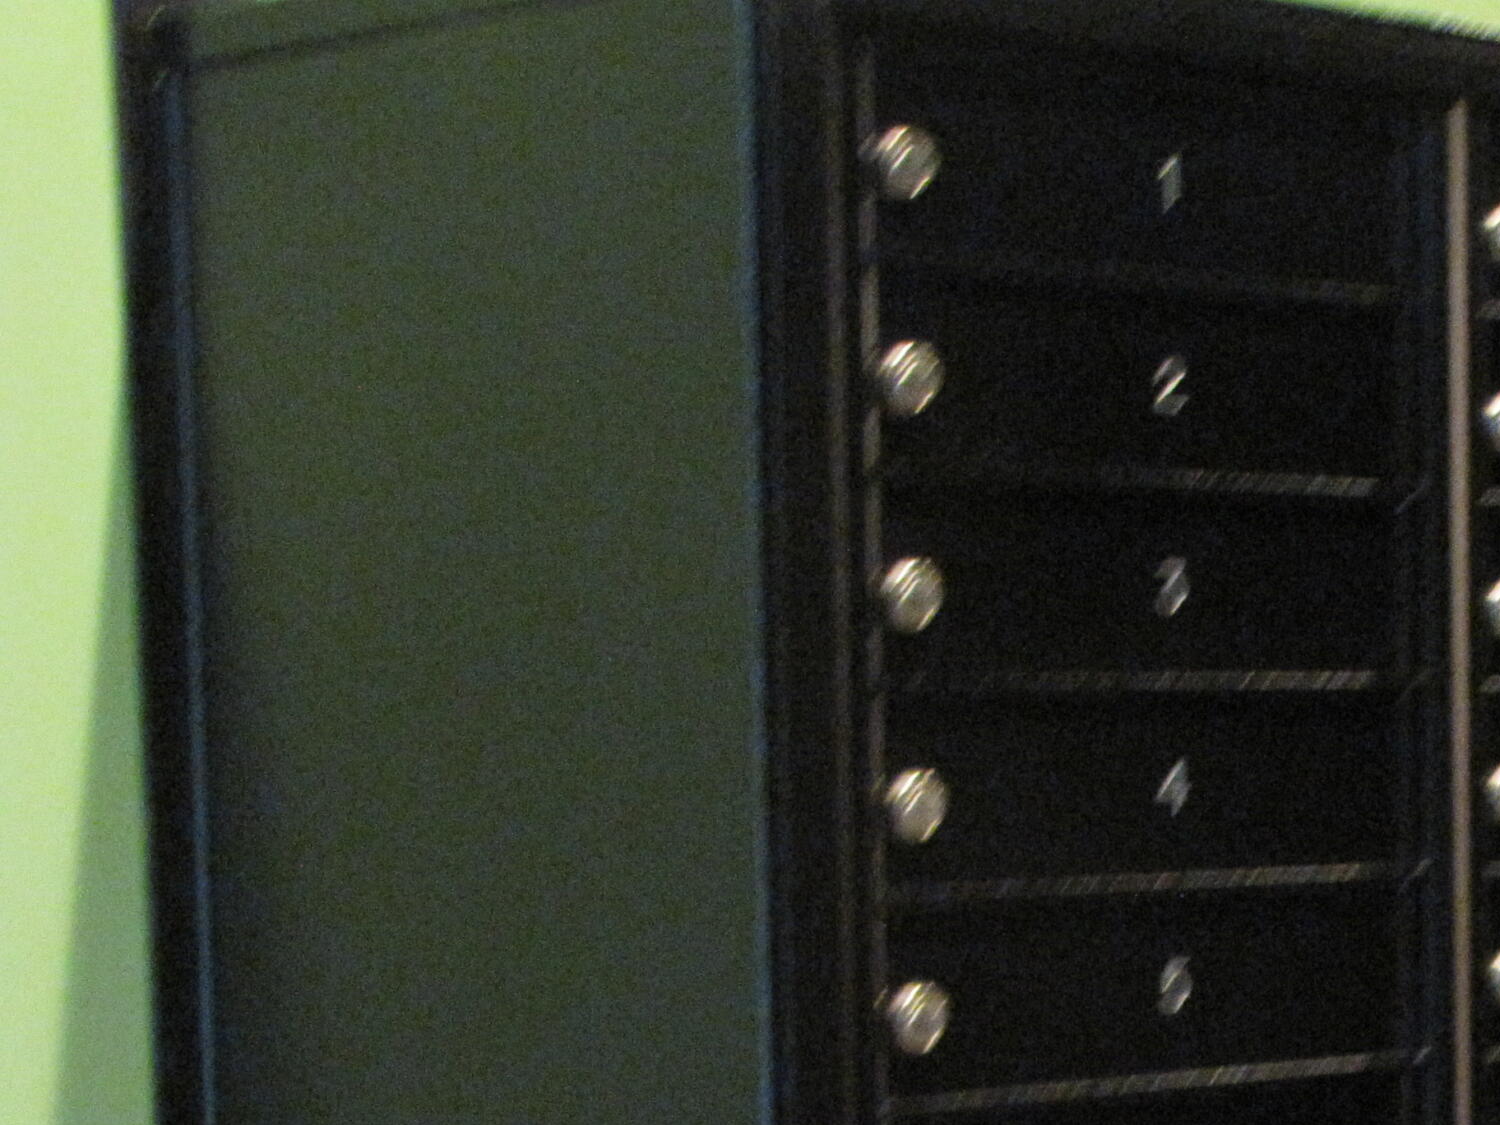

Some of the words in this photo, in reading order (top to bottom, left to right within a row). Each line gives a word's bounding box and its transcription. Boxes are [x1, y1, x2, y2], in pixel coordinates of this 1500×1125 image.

[1156, 152, 1184, 214] 1
[1151, 354, 1191, 416] 2
[1153, 555, 1191, 618] 3
[1155, 759, 1191, 815] 4
